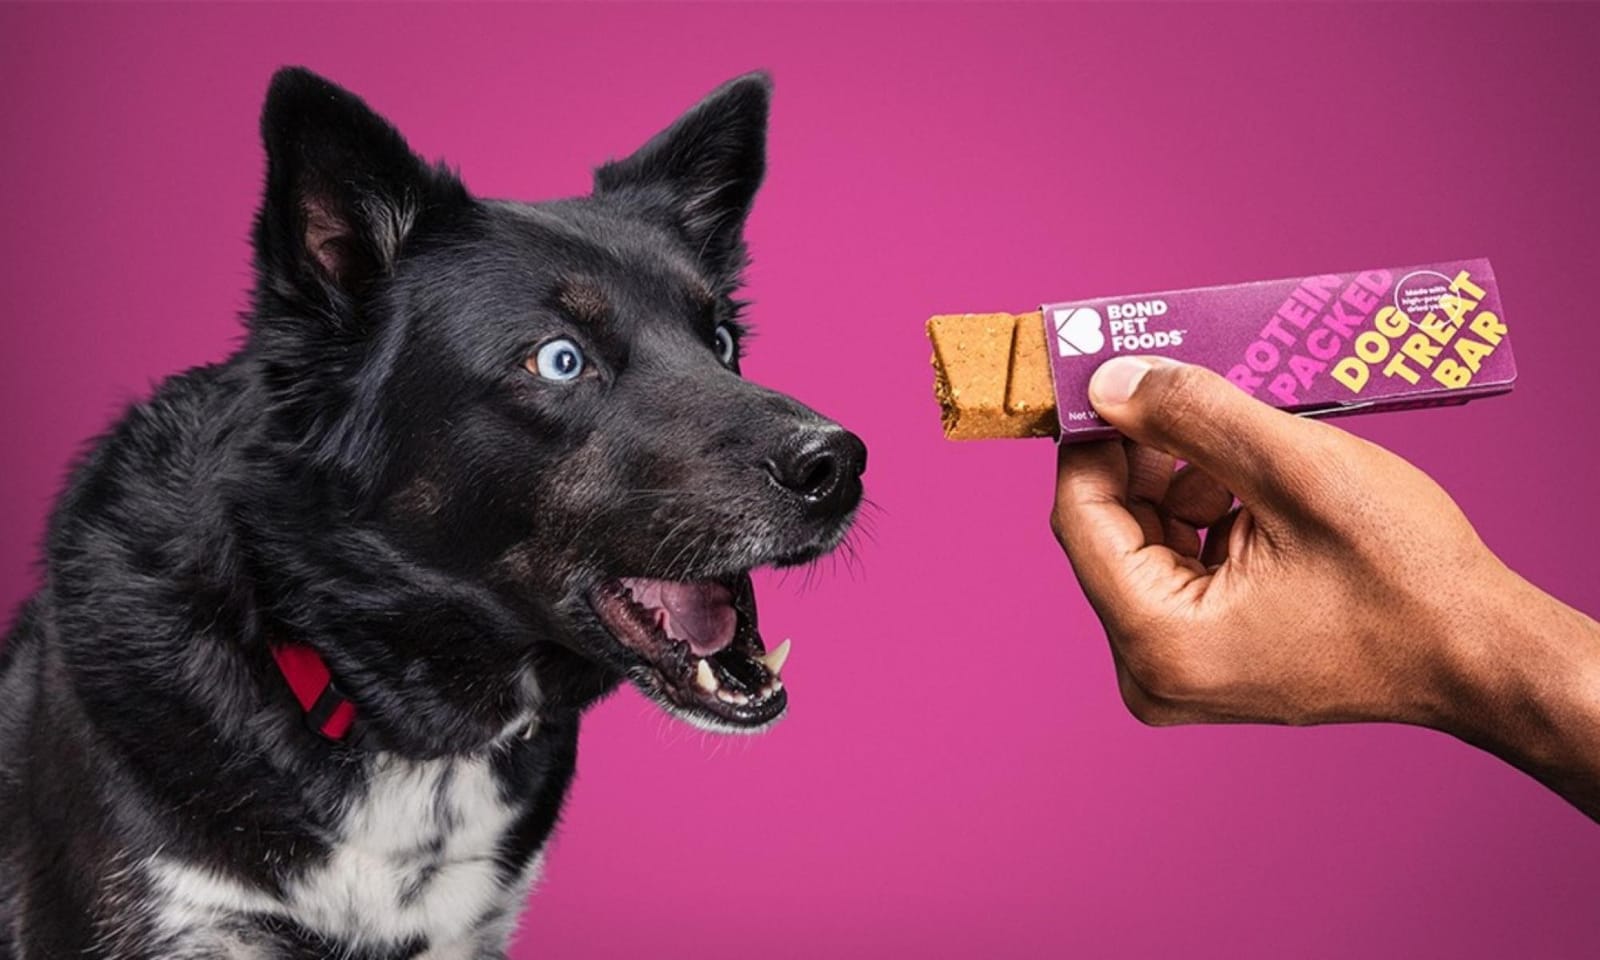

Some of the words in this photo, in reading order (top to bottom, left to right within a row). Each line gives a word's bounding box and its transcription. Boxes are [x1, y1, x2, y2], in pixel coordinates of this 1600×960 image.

[1107, 300, 1168, 319] BOND
[1109, 317, 1148, 336] PET
[1226, 273, 1343, 396] ROTEIN
[1267, 268, 1393, 405] PACKED
[1330, 305, 1411, 394] DOG
[1382, 270, 1487, 385] TREAT
[1431, 311, 1508, 389] BAR
